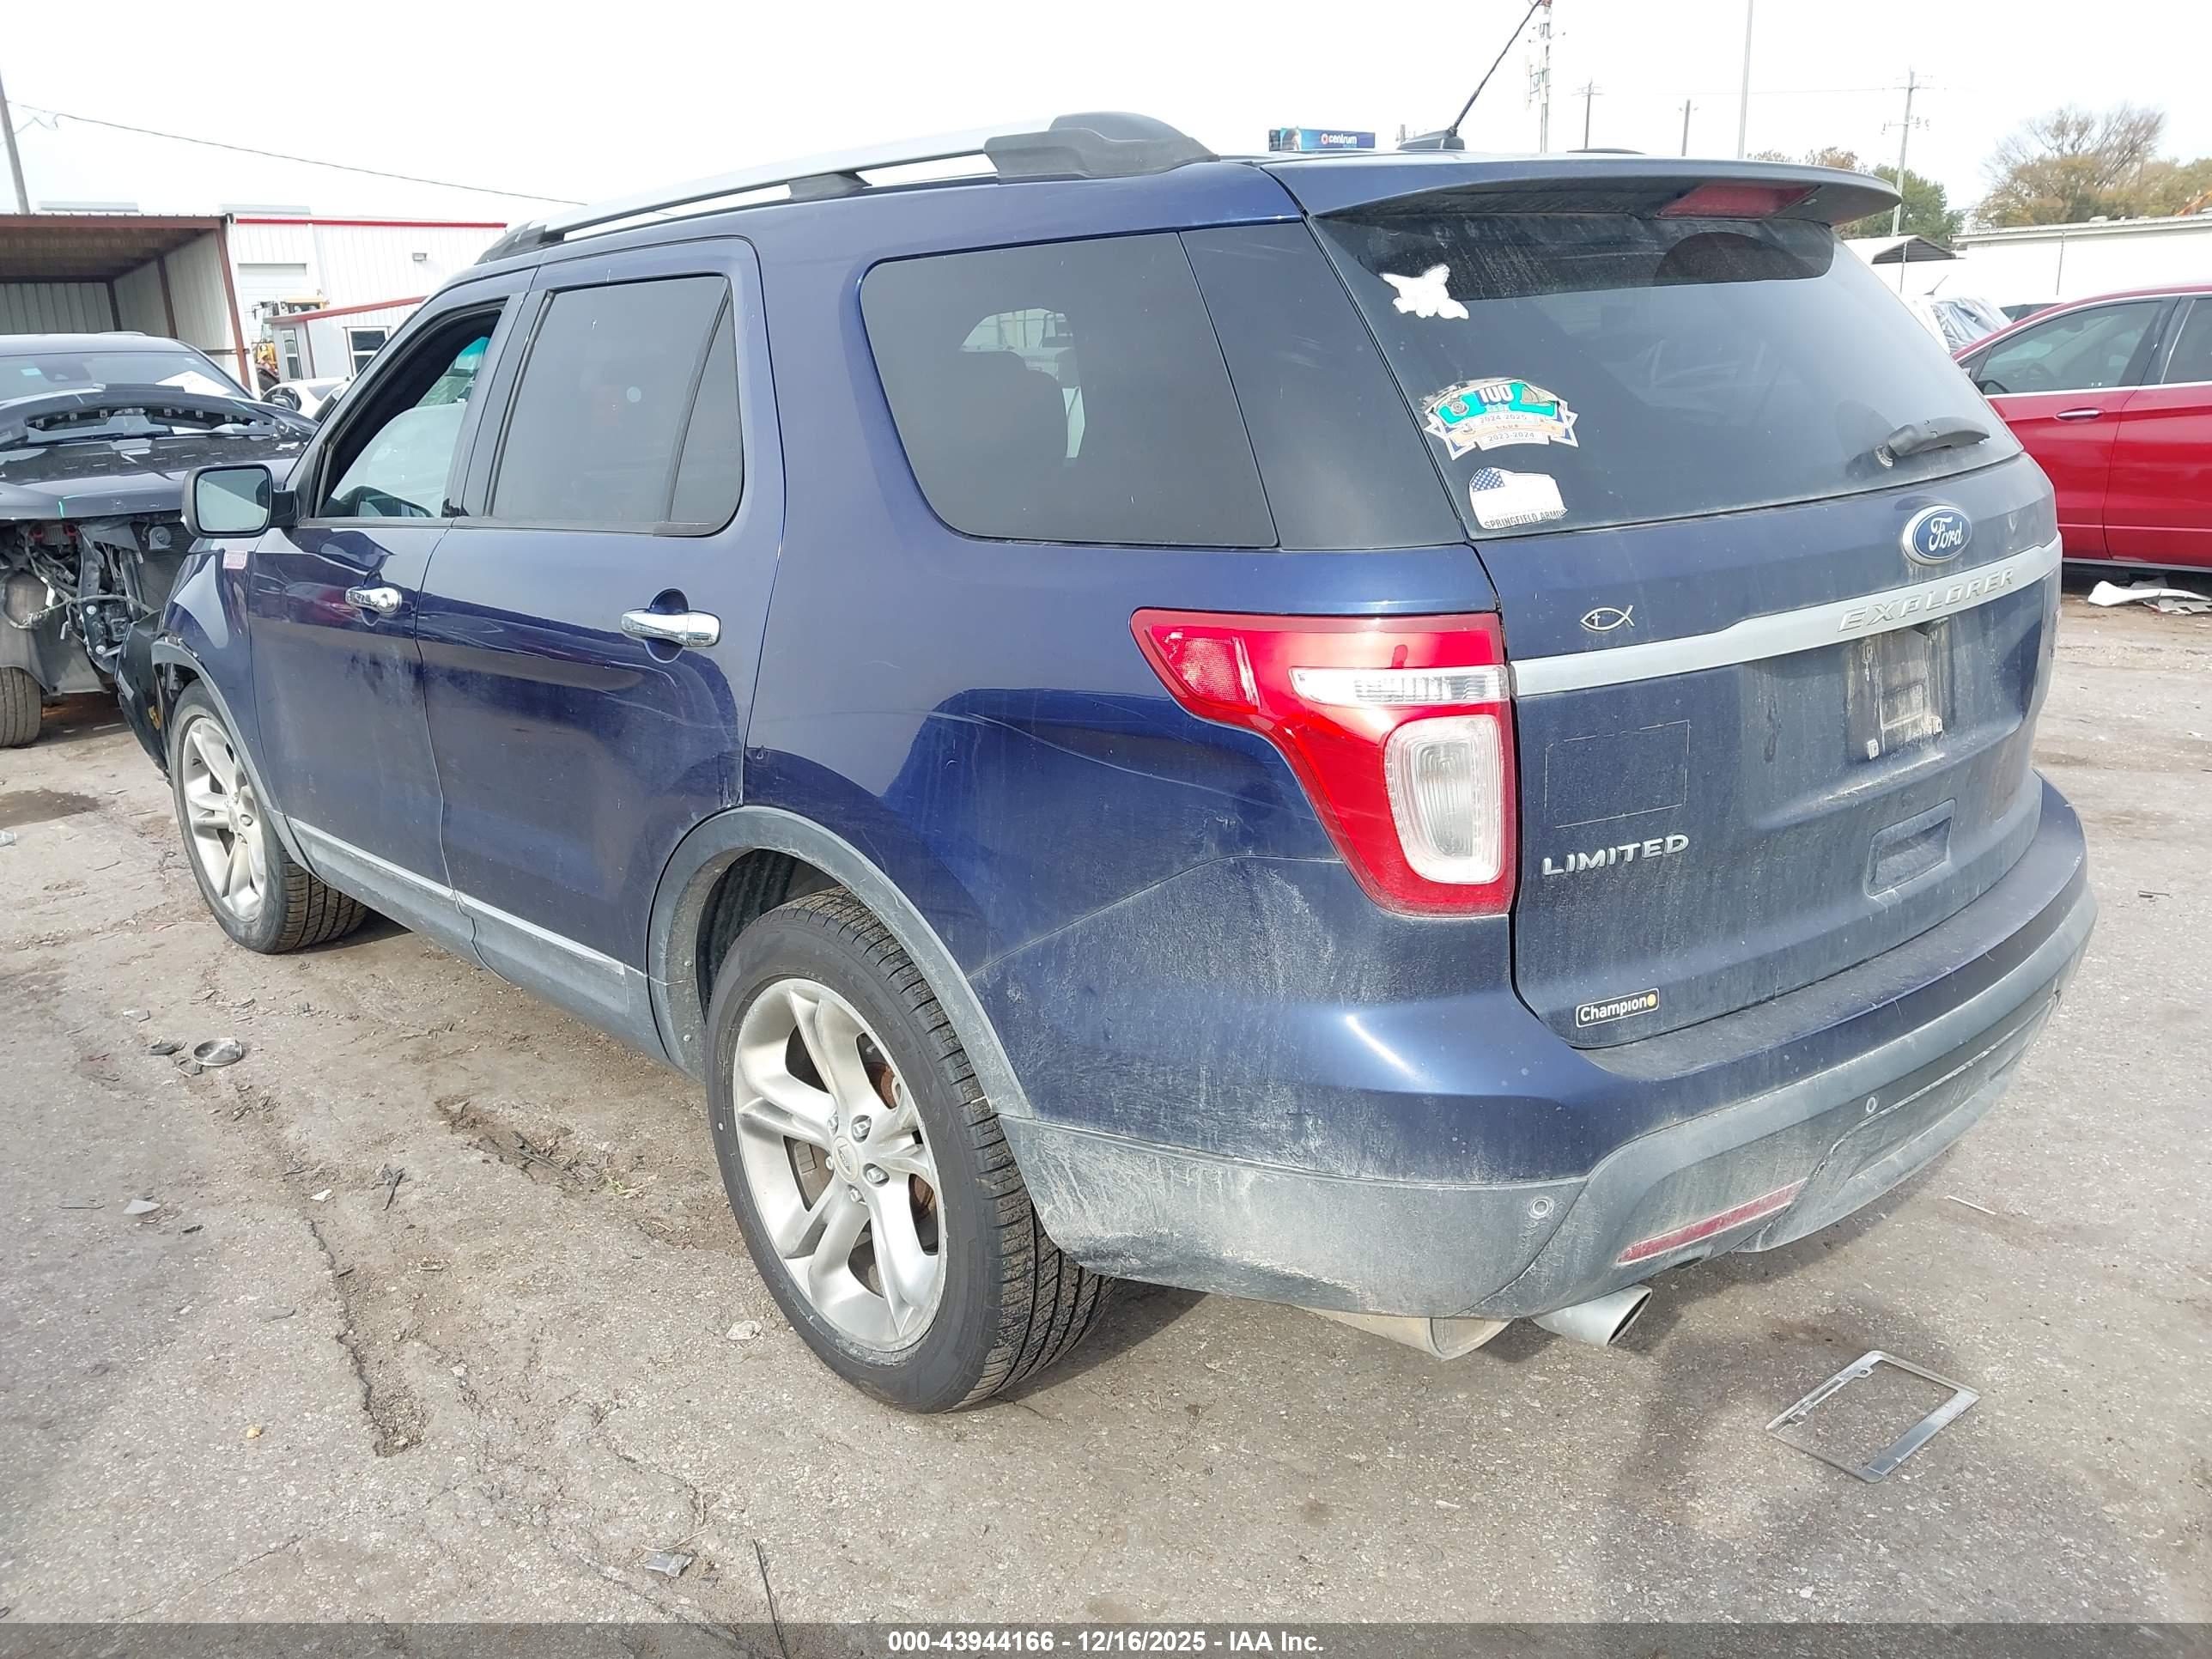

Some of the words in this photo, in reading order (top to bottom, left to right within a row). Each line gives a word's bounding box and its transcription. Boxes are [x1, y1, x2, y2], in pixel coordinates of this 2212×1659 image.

[1328, 133, 1357, 144] centrum
[1488, 431, 1534, 442] 2023-2024
[1484, 513, 1539, 528] SPRINGFIELD
[1929, 515, 1964, 551] Ford
[1838, 567, 2014, 632] EXPLORER
[1542, 834, 1689, 876] LIMITED
[1580, 996, 1647, 1022] Champion
